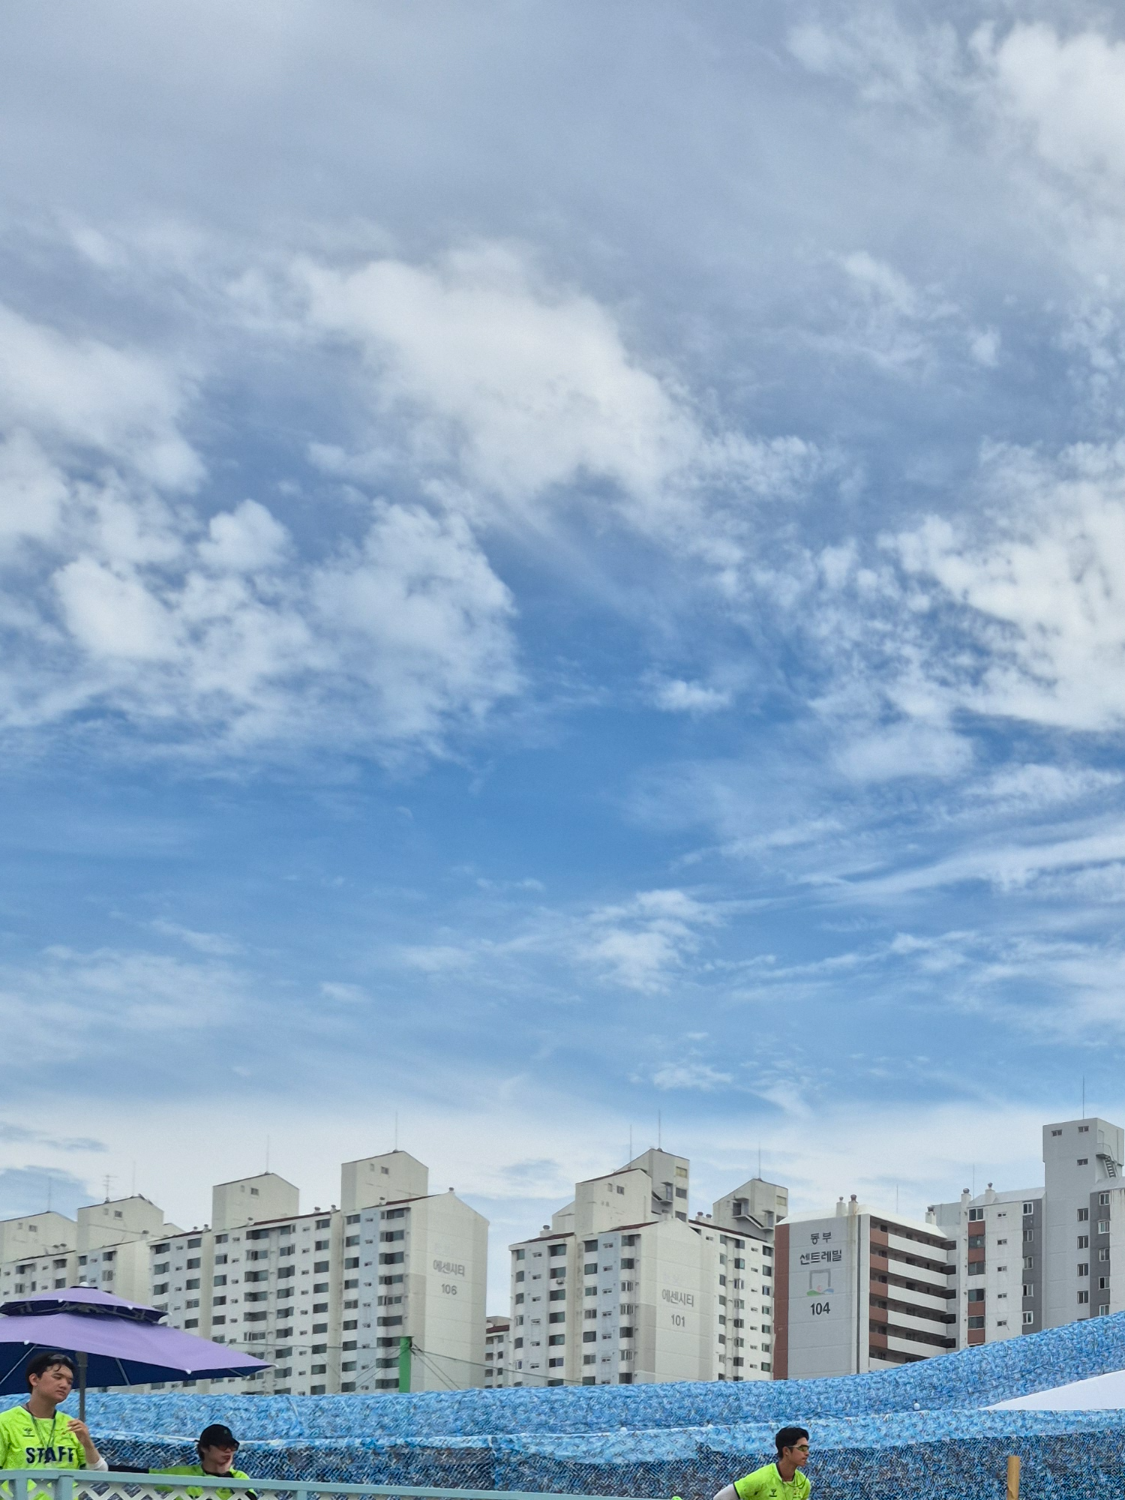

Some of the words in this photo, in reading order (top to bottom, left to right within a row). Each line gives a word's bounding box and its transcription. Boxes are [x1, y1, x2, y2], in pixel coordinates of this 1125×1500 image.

[810, 1232, 832, 1246] 동부
[799, 1249, 843, 1266] 센트레빌
[441, 1283, 458, 1296] 106
[661, 1288, 694, 1307] 에센시티
[810, 1302, 831, 1316] 104
[671, 1314, 685, 1328] 101
[26, 1447, 75, 1465] STAFF
